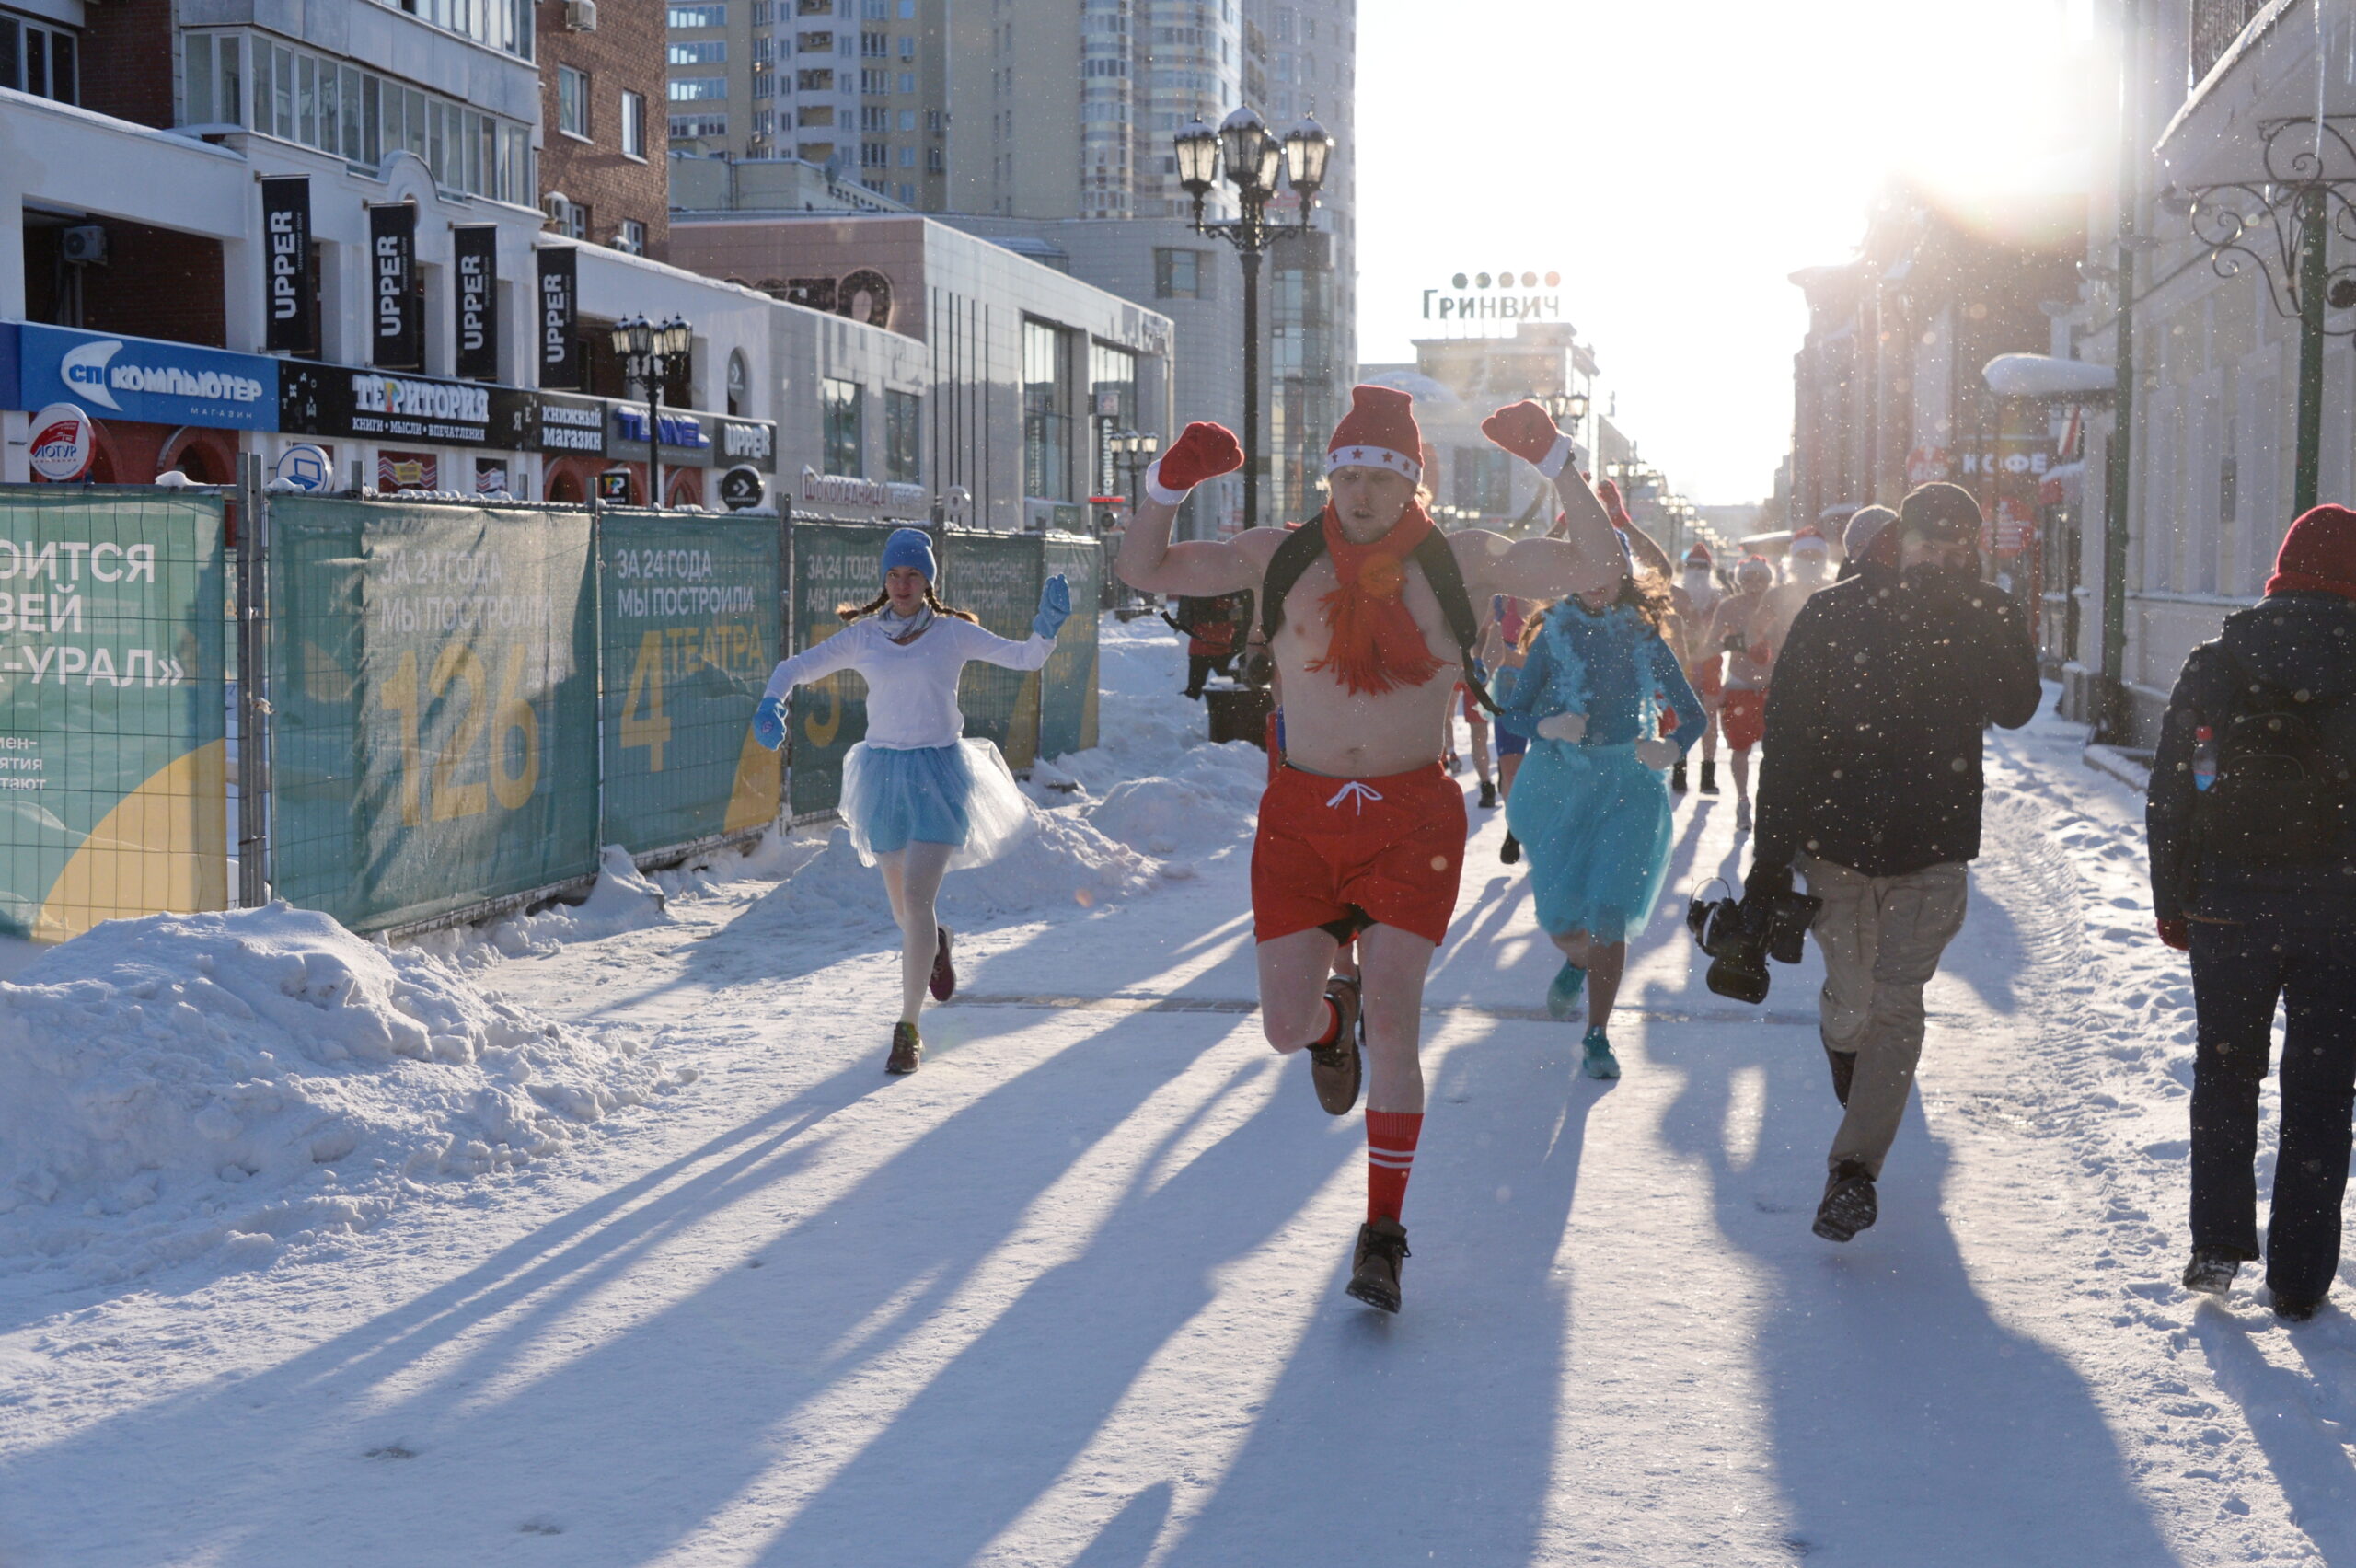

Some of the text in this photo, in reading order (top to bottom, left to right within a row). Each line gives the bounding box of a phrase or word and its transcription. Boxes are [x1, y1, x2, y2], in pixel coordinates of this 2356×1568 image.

[271, 211, 296, 318] UPPER
[377, 236, 402, 336] UPPER
[461, 255, 484, 350] UPPER
[544, 274, 565, 363] UPPER
[69, 364, 263, 402] СП КОМПЬЮТЕР
[352, 374, 490, 422] ТЕРРИТОРИЯ
[191, 408, 253, 419] МАГАЗИН
[352, 417, 485, 441] КНИГИ МЫСЛИ ВПЕЧАТЛЕНИЯ
[35, 445, 77, 457] ЛОТУР
[724, 423, 771, 458] UPPER
[380, 550, 502, 585] ЗА 24 ГОДА
[617, 549, 712, 581] ЗА 24 ГОДА
[807, 555, 880, 582] ЗА 24 ГОДА
[381, 595, 552, 632] МЫ ПОСТРОИЛИ
[618, 585, 755, 617] МЫ ПОСТРОИЛИ
[806, 589, 829, 612] МЫ
[0, 646, 184, 687] -УРАЛ»
[666, 625, 766, 673] ТЕАТРА
[619, 630, 671, 773] 4
[380, 644, 539, 826] 126
